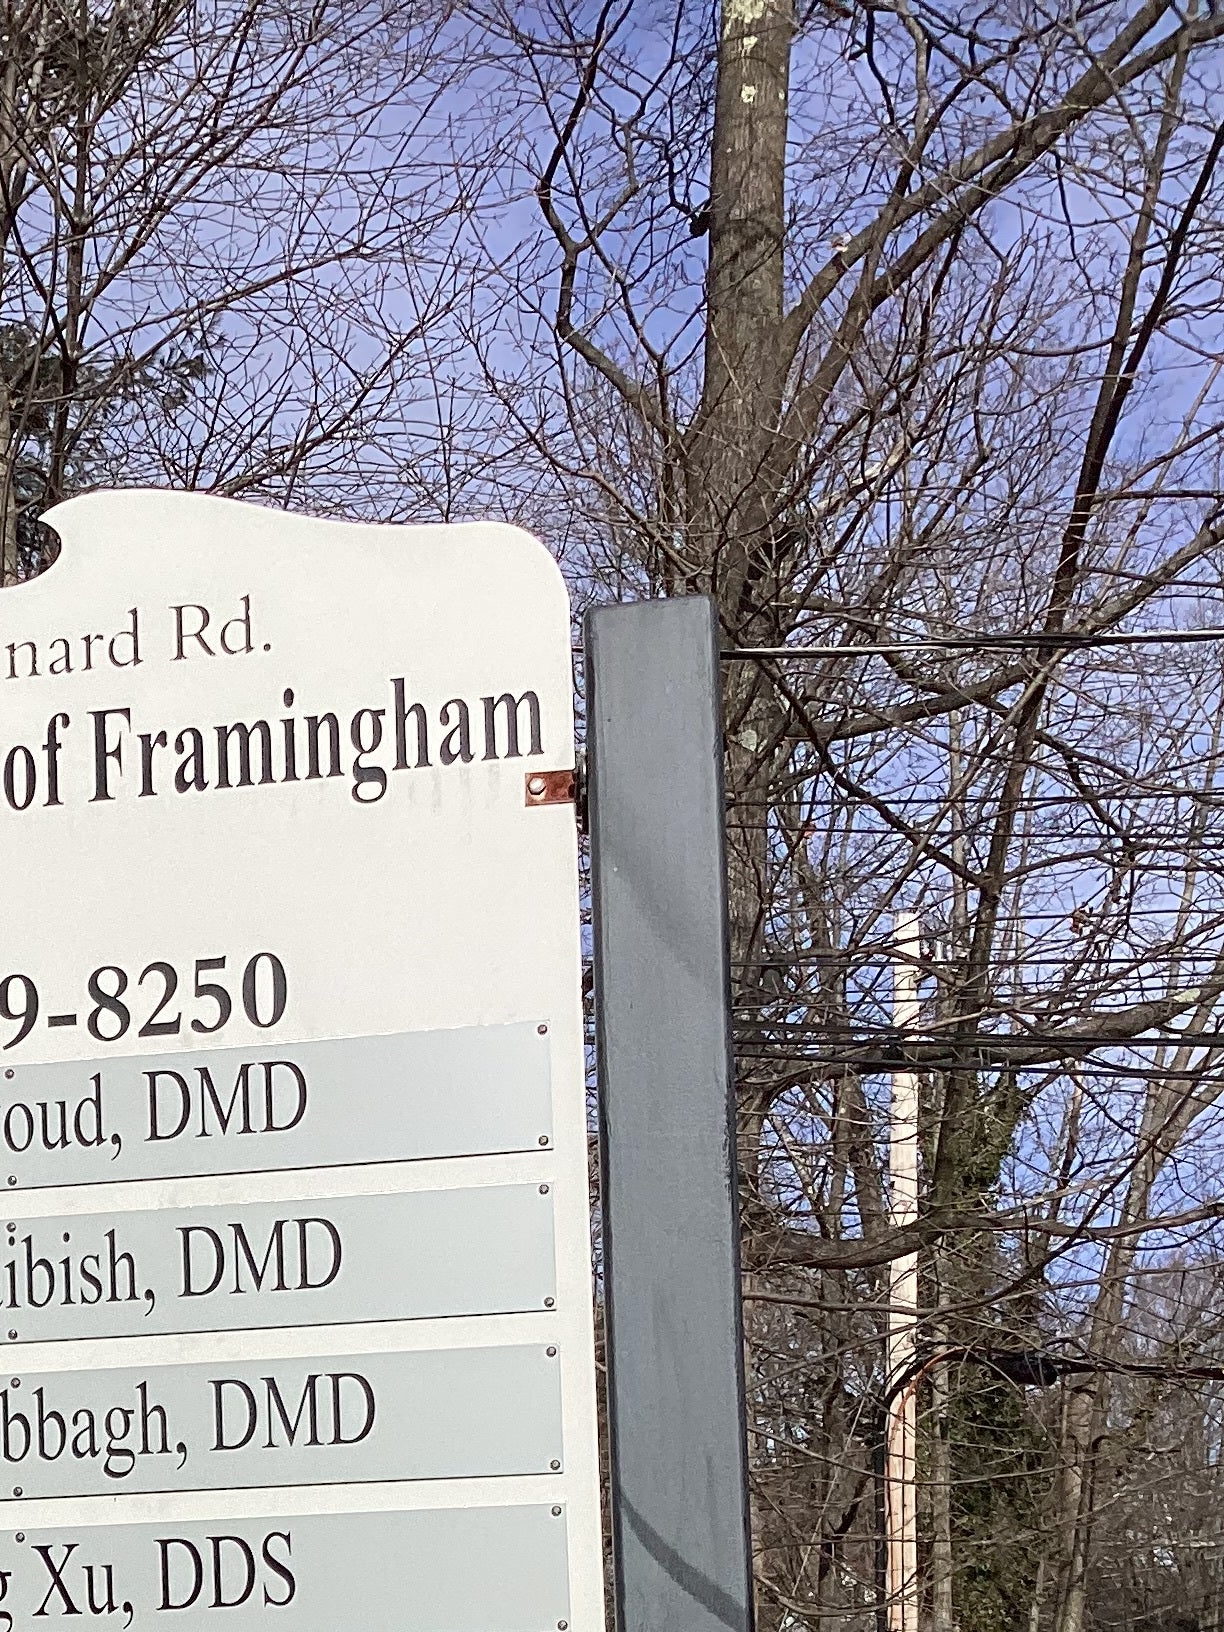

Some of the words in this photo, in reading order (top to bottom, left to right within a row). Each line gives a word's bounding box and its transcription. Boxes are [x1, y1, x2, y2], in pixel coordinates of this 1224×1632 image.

[169, 594, 271, 660] Rd.
[4, 713, 70, 810] of
[87, 677, 544, 803] Framingham
[142, 1061, 307, 1141] DMD
[176, 1218, 341, 1297] DMD
[208, 1373, 375, 1451] DMD
[31, 1544, 133, 1629] Xu,
[154, 1531, 295, 1610] DDS
